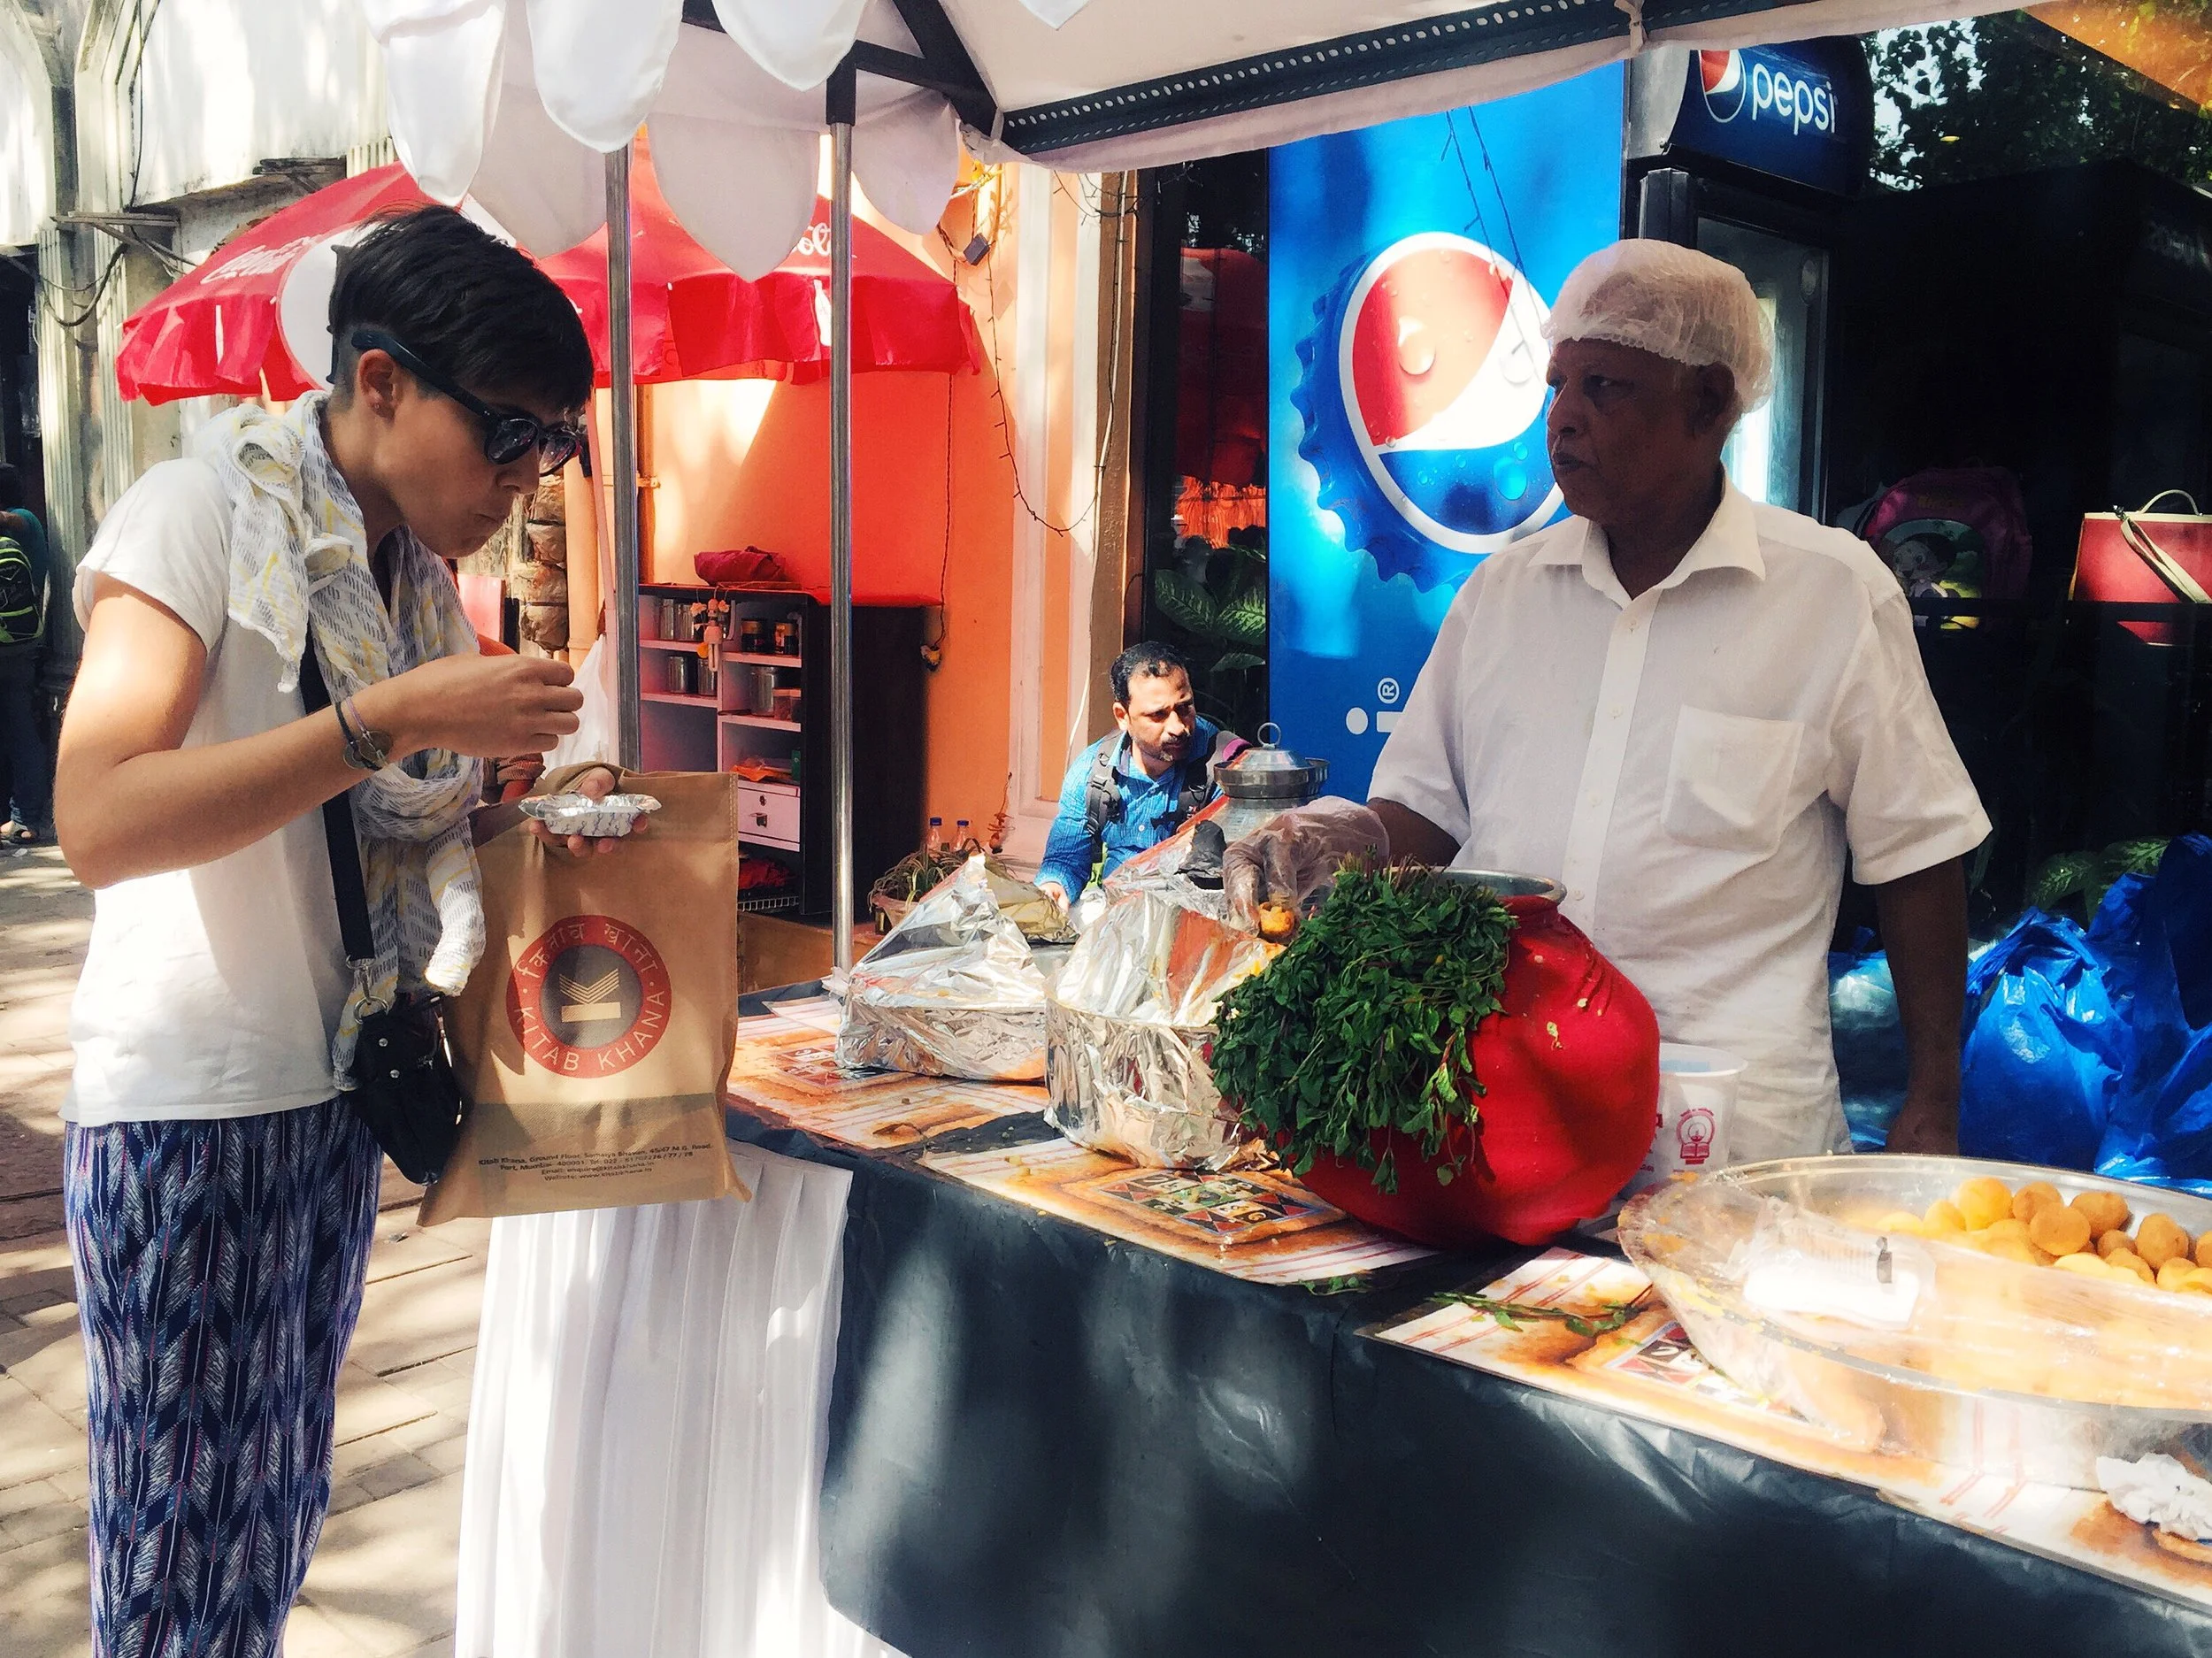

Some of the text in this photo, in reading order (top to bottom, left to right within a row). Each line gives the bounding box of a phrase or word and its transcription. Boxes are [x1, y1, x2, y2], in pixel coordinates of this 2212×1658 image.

[1752, 63, 1836, 135] pepsi
[604, 923, 658, 974] खाना
[514, 990, 664, 1071] KITAB KHANA
